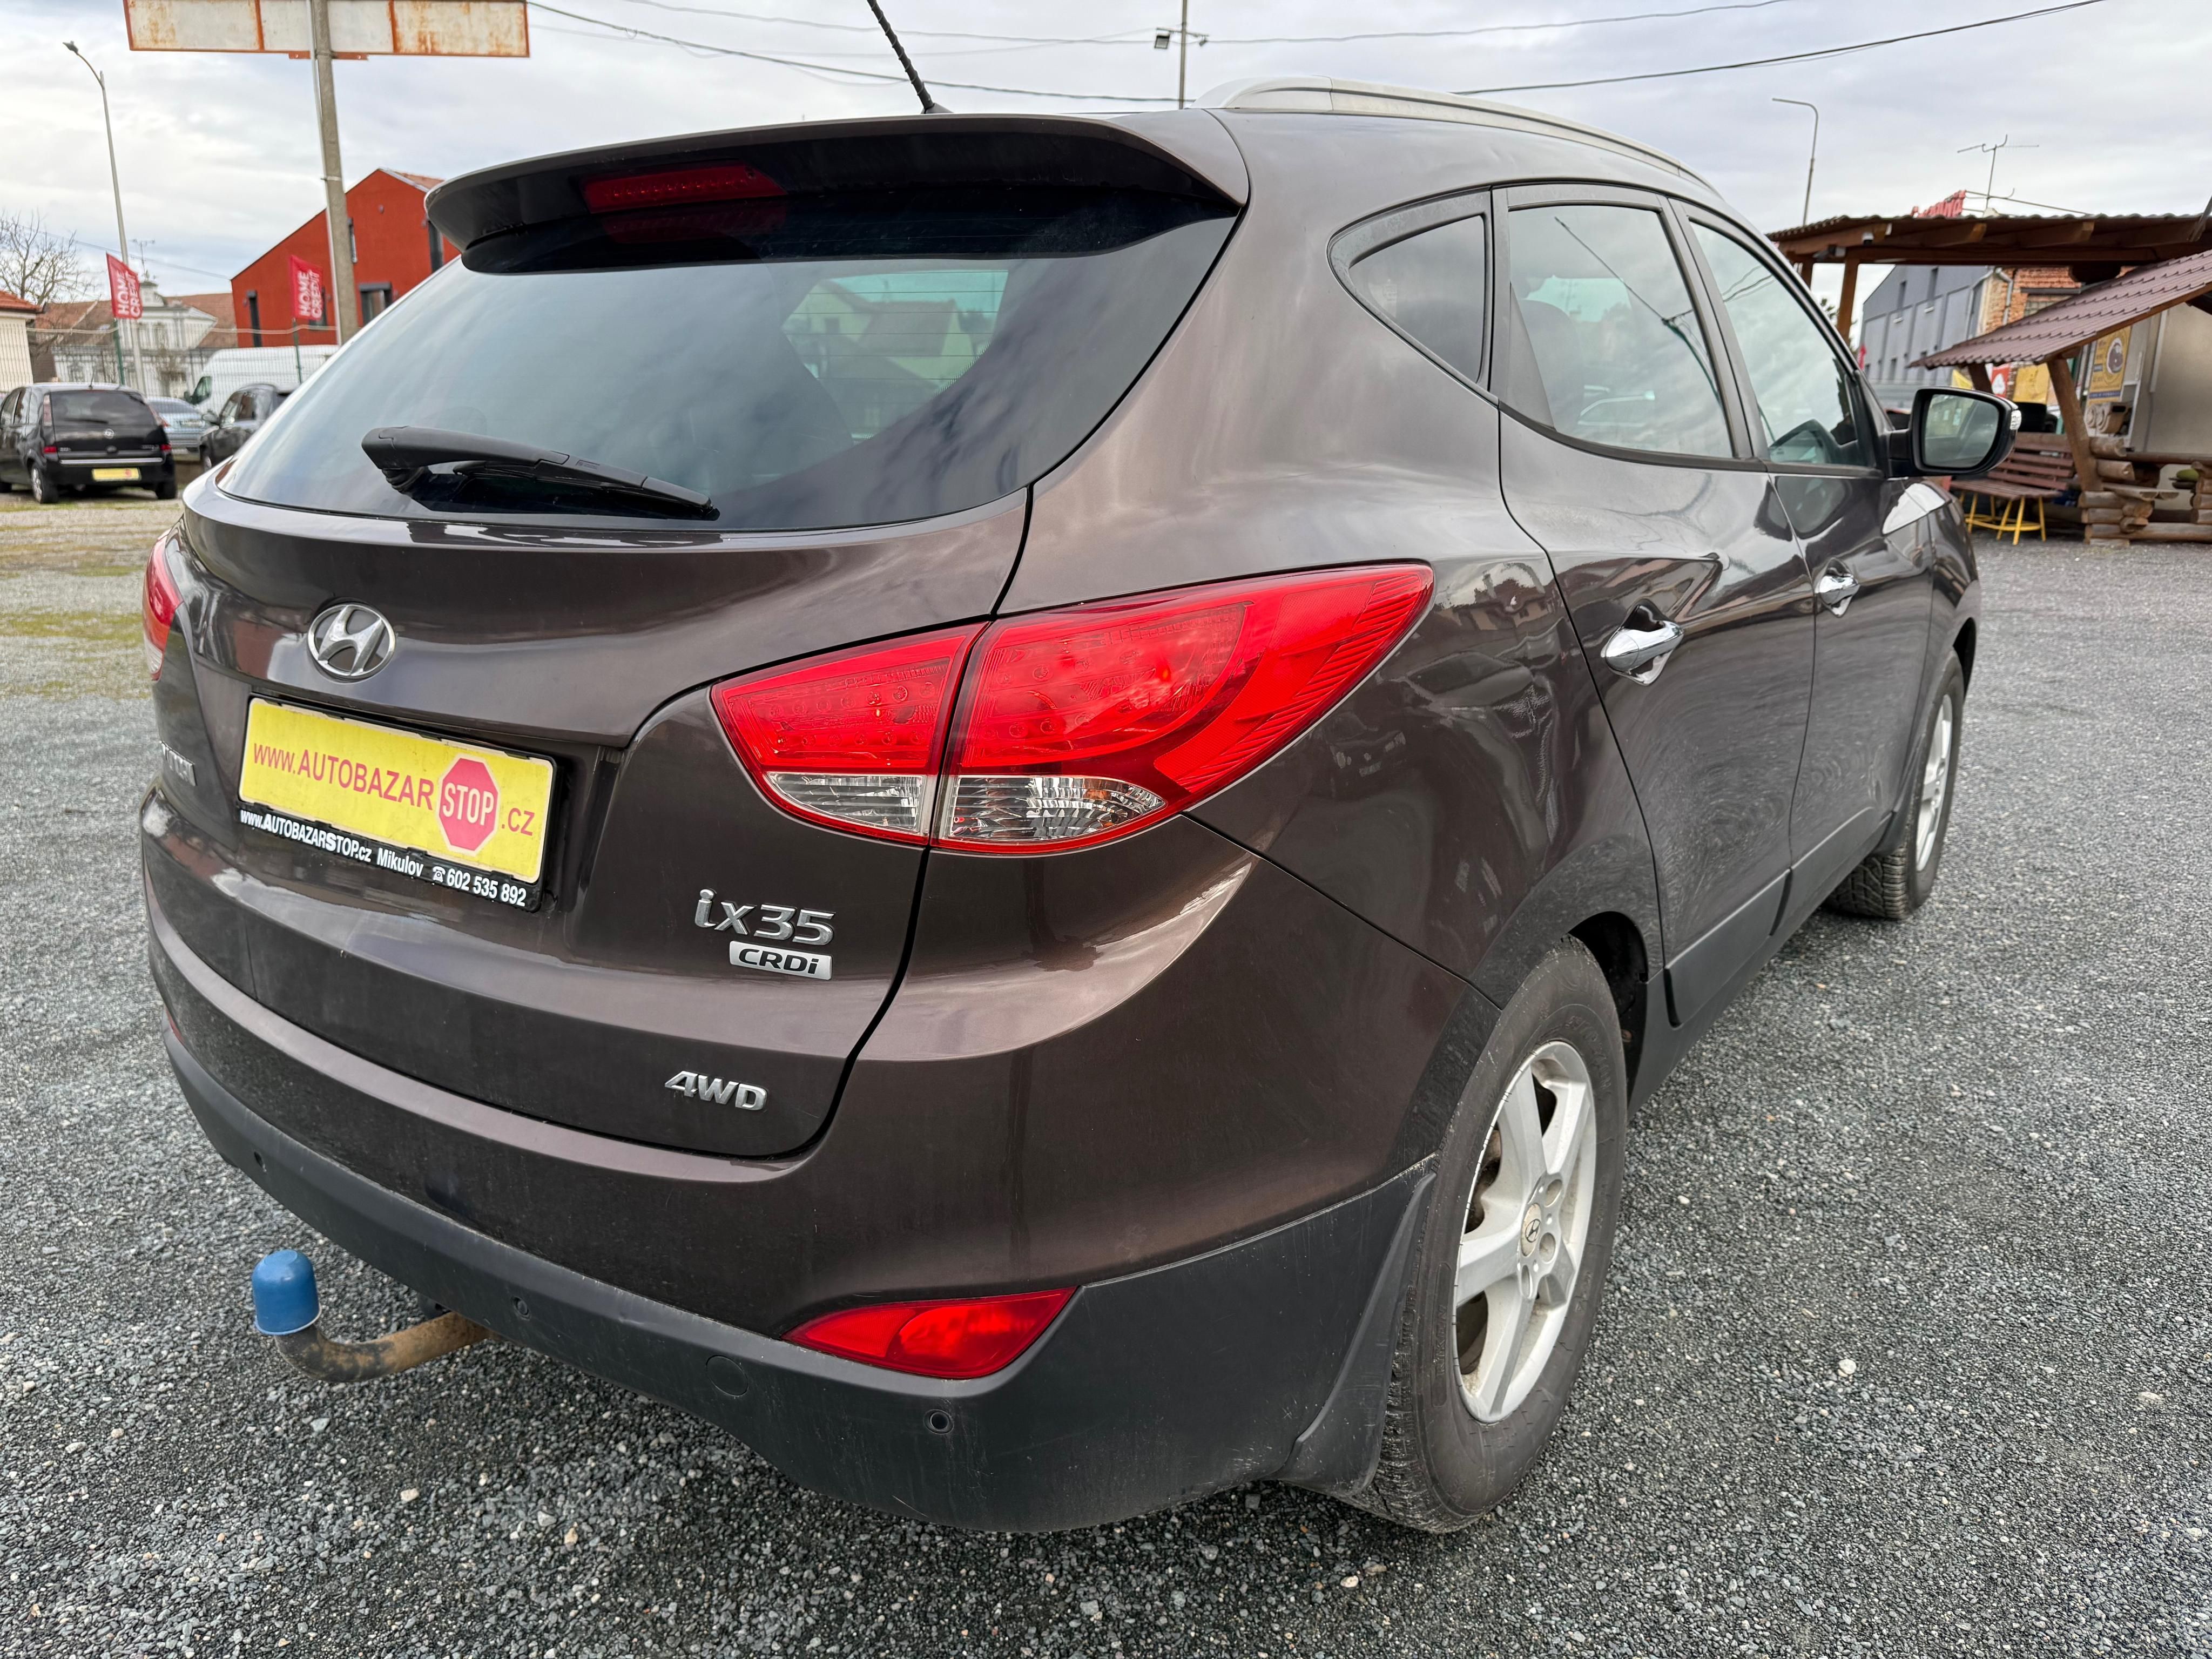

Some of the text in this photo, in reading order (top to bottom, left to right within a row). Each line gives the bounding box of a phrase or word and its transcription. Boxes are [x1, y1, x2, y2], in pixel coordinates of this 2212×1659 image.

[117, 270, 130, 315] HOME
[298, 271, 311, 316] HOME
[376, 846, 424, 878] Mikulov
[447, 868, 471, 891] 602
[473, 875, 499, 899] 535
[501, 883, 527, 907] 892
[694, 889, 835, 946] ix35
[738, 948, 820, 974] CRDi
[664, 1070, 768, 1111] 4WD
